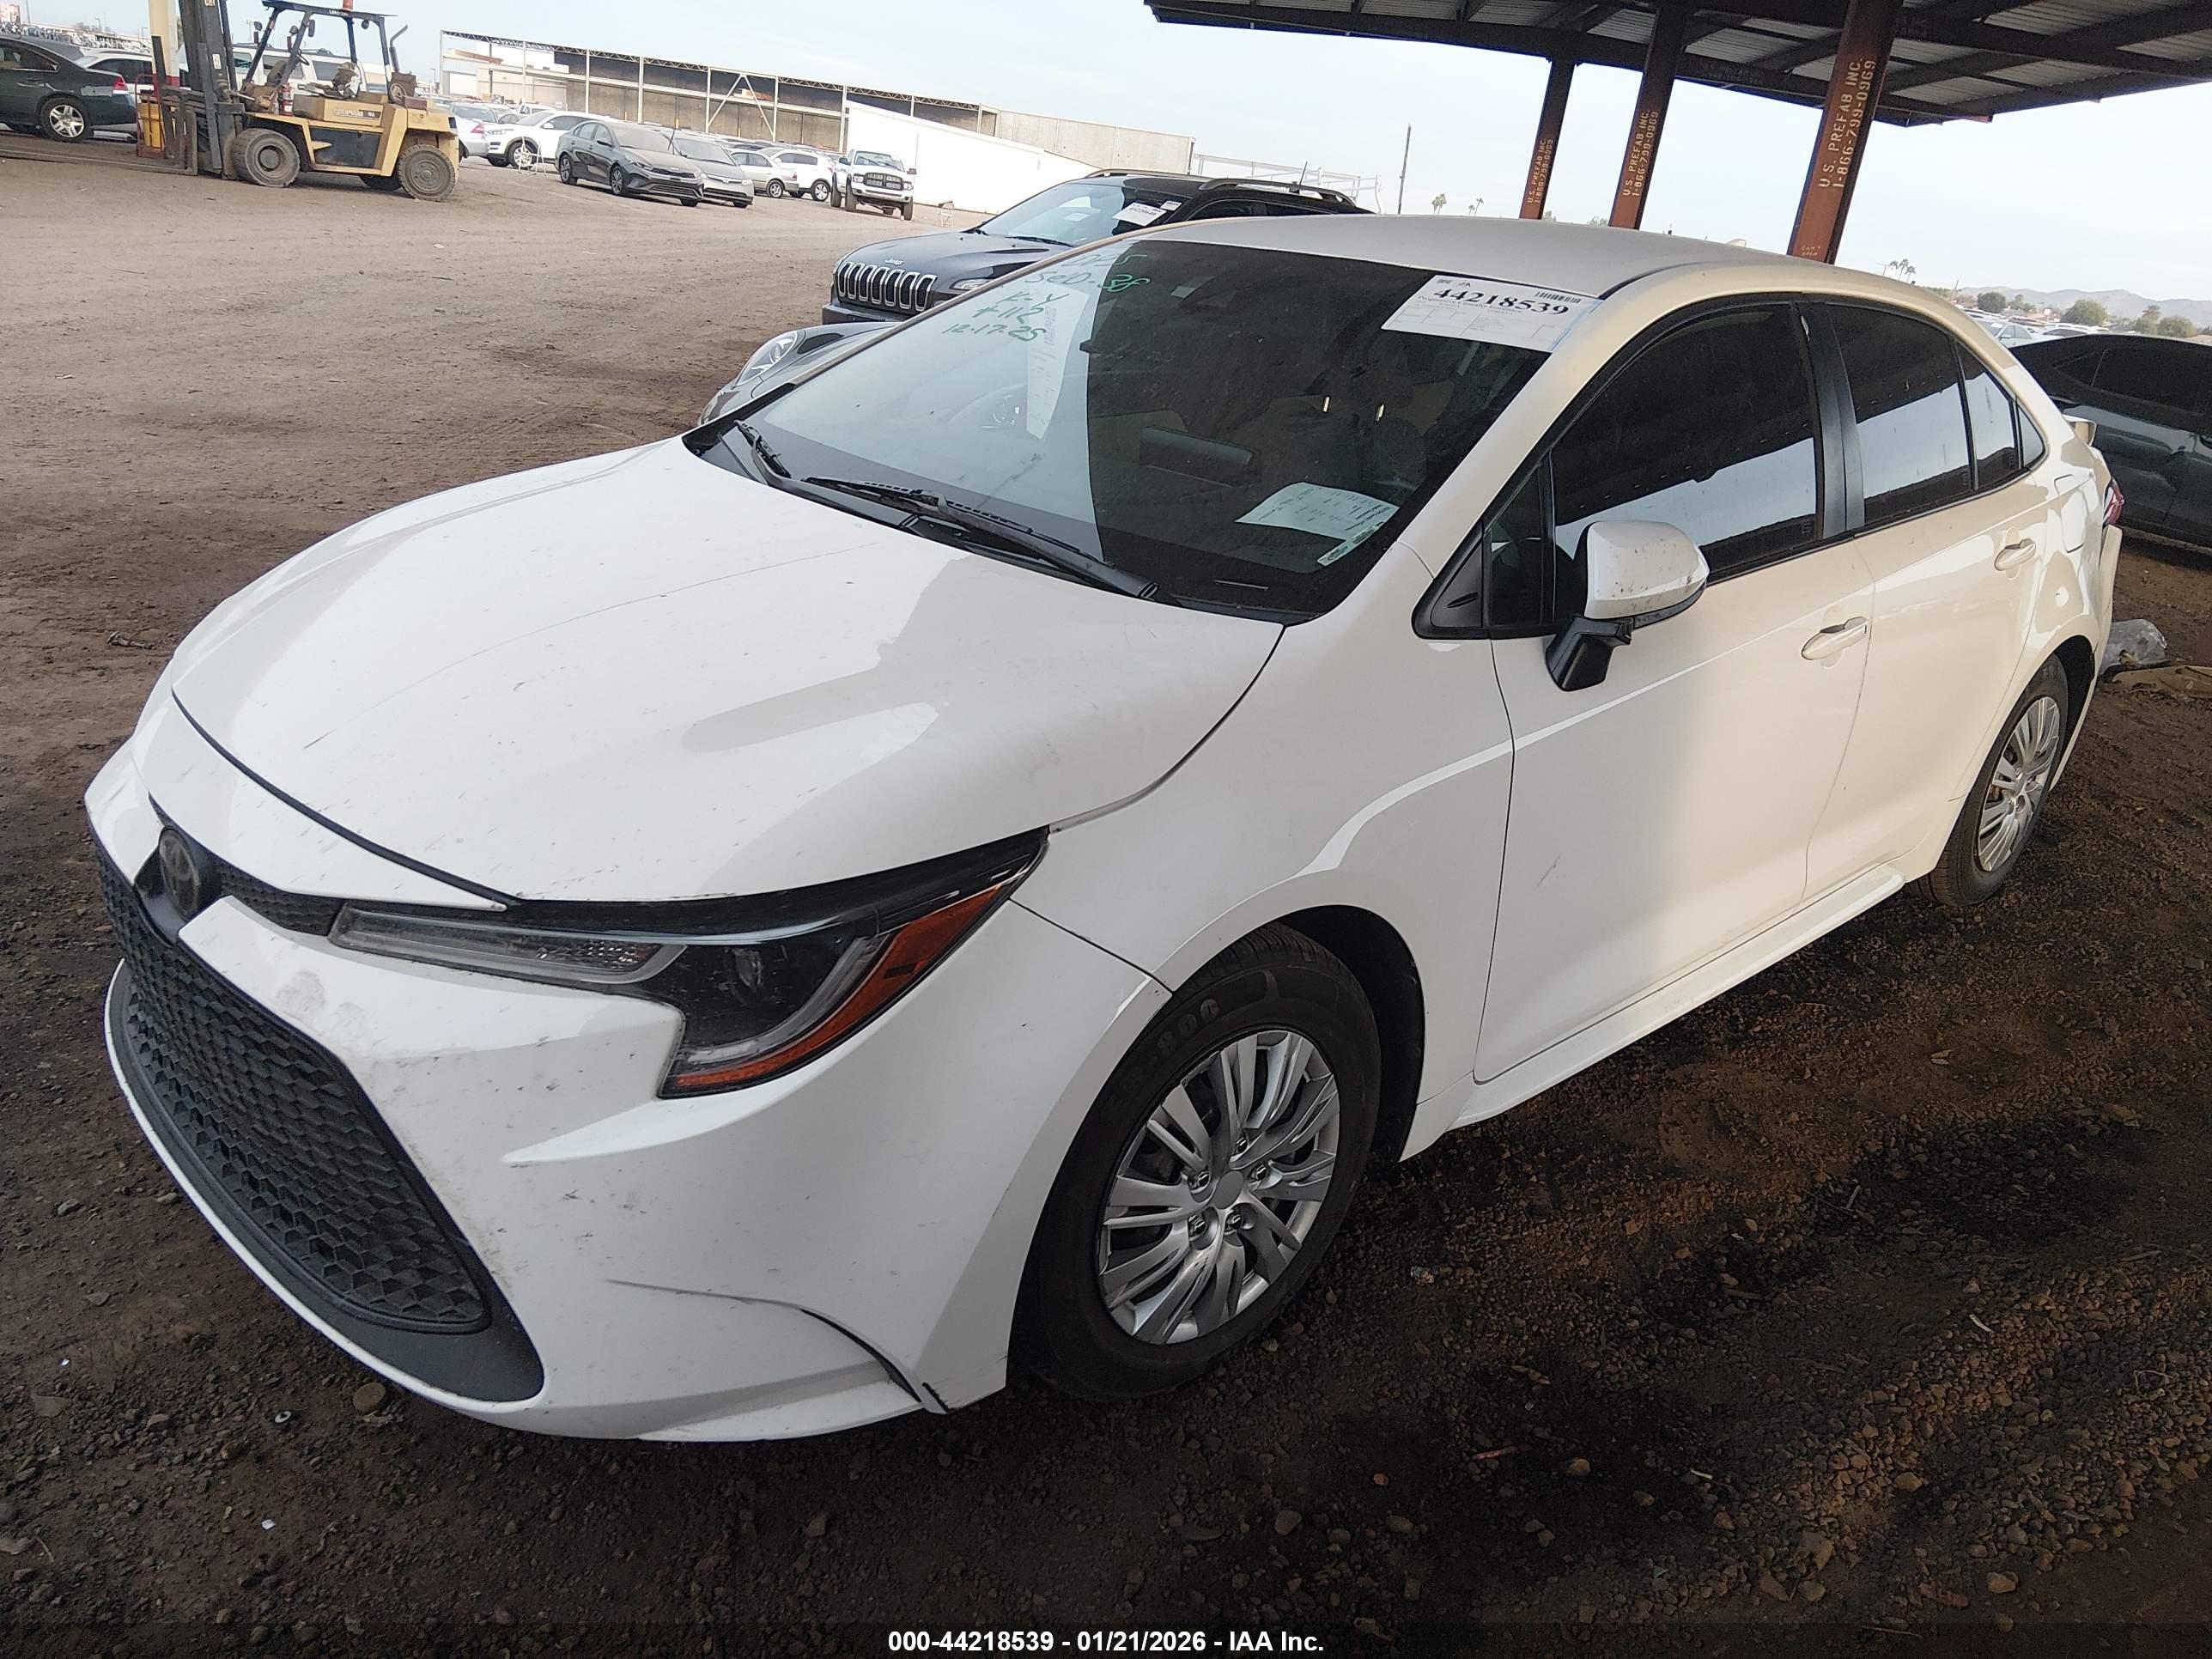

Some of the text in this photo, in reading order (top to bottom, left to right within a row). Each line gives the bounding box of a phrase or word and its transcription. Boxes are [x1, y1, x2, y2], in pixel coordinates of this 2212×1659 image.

[1628, 133, 1644, 172] PREFAB
[1632, 112, 1658, 196] 1-866-799-0969
[1818, 58, 1863, 187] U.S. PREFAB INC.
[1832, 60, 1876, 187] 1-866-799-0969
[1434, 289, 1569, 315] 44218539
